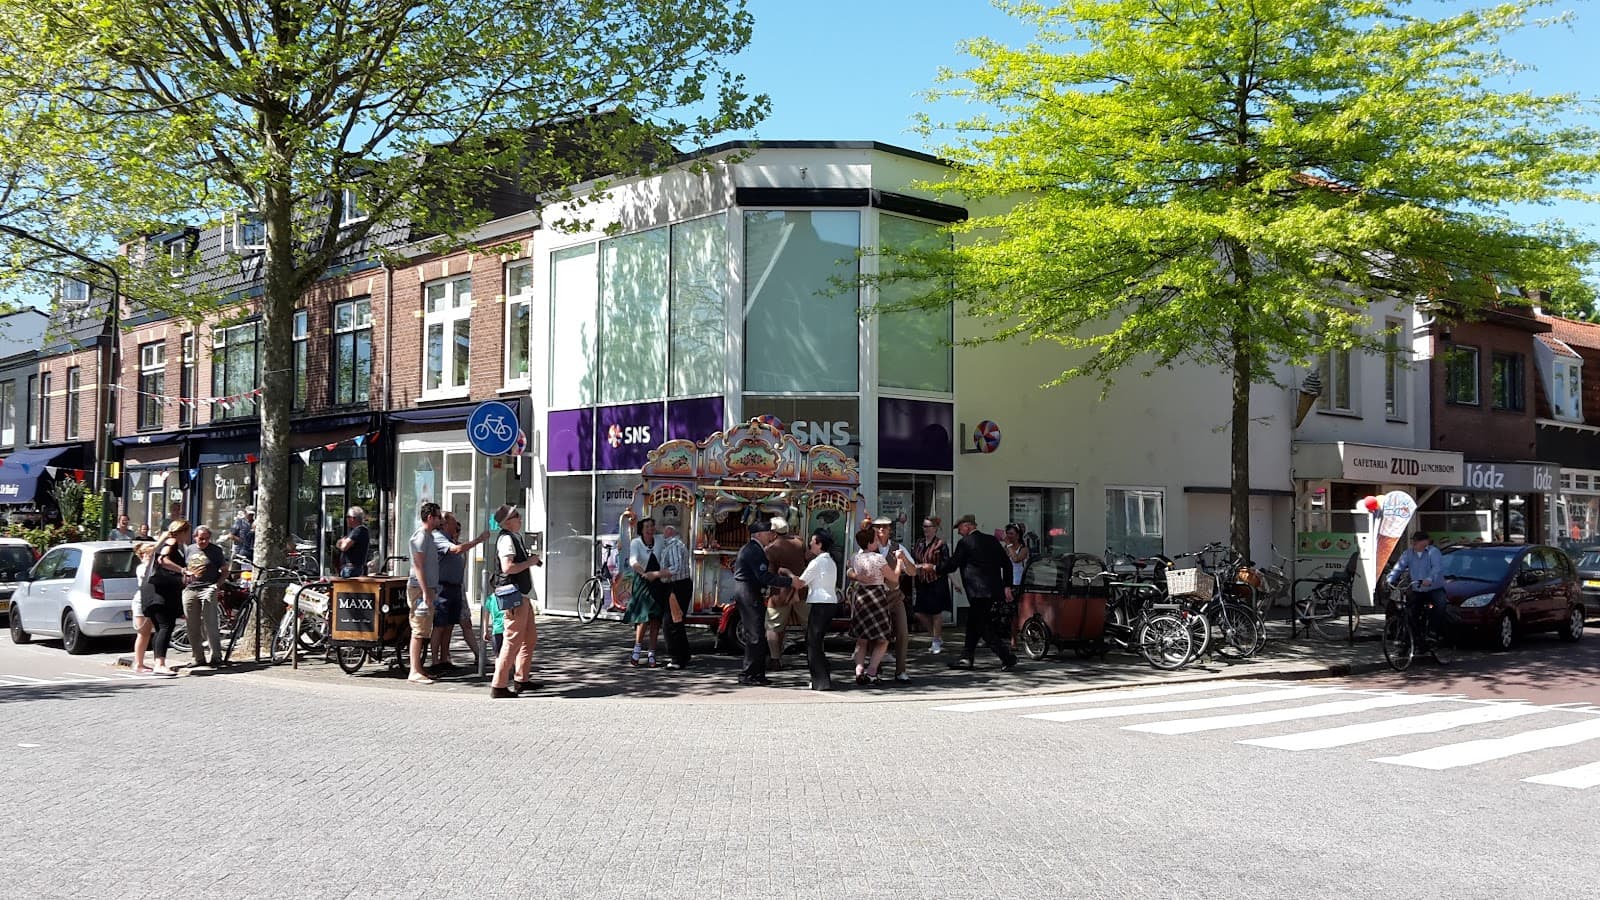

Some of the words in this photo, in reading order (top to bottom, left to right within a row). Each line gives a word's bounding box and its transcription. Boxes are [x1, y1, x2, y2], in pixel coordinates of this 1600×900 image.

[624, 426, 651, 444] SNS
[791, 421, 850, 446] SNS
[1353, 458, 1388, 468] CAFETARIA
[1391, 458, 1419, 475] ZUID
[1421, 464, 1455, 473] LUNCHROOM
[1467, 463, 1504, 488] lódz
[338, 598, 373, 610] MAXX
